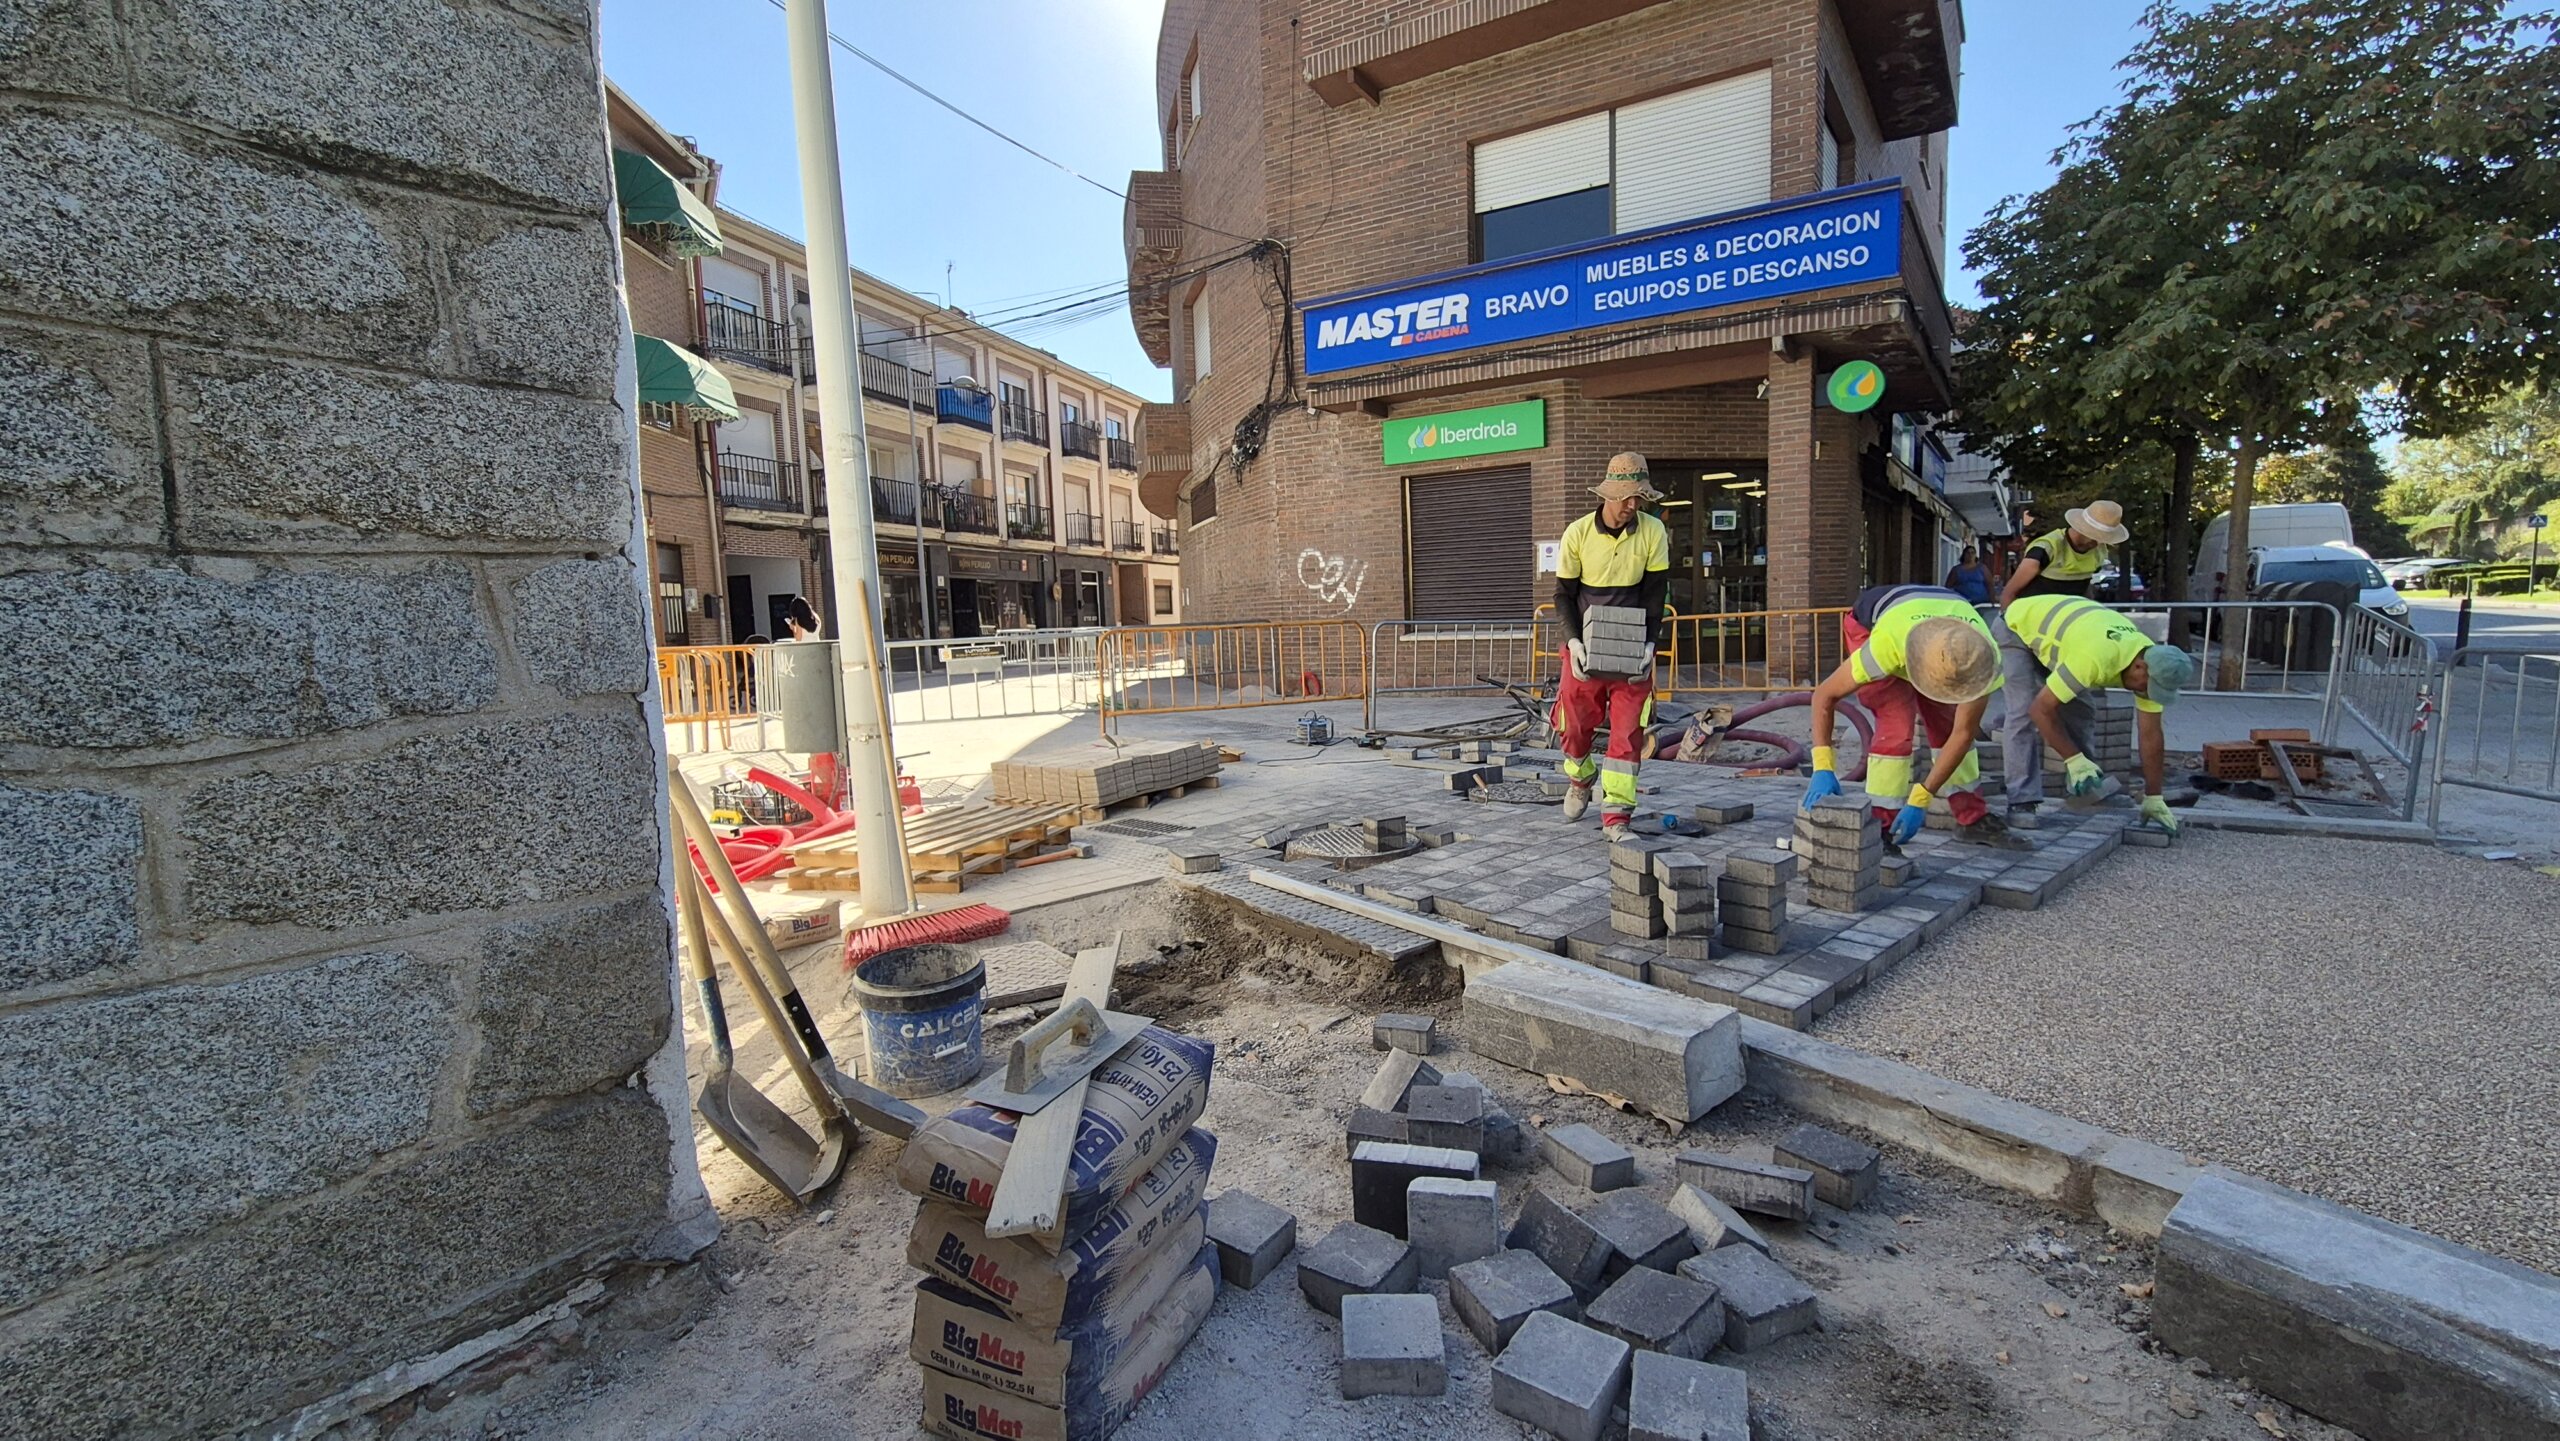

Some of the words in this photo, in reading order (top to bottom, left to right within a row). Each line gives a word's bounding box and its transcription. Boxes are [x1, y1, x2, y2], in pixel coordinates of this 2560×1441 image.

[1586, 247, 1688, 283] MUEBLES
[1693, 243, 1710, 263] &
[1715, 209, 1881, 259] DECORACION
[1594, 277, 1690, 311] EQUIPOS
[1696, 270, 1727, 293] DE
[1733, 245, 1870, 287] DESCANSO
[1317, 293, 1470, 349] MASTER
[1485, 284, 1569, 319] BRAVO
[1415, 323, 1470, 343] CADENA
[1441, 419, 1517, 445] Iberdrola
[792, 914, 830, 931] BigMat
[1158, 1061, 1184, 1083] 25
[1128, 1079, 1159, 1107] CEM
[929, 1162, 995, 1209] BigM
[936, 1231, 1020, 1299] BigMat
[930, 1350, 948, 1366] CEM
[943, 1319, 1025, 1371] BigMat
[944, 1393, 1023, 1439] BigMat
